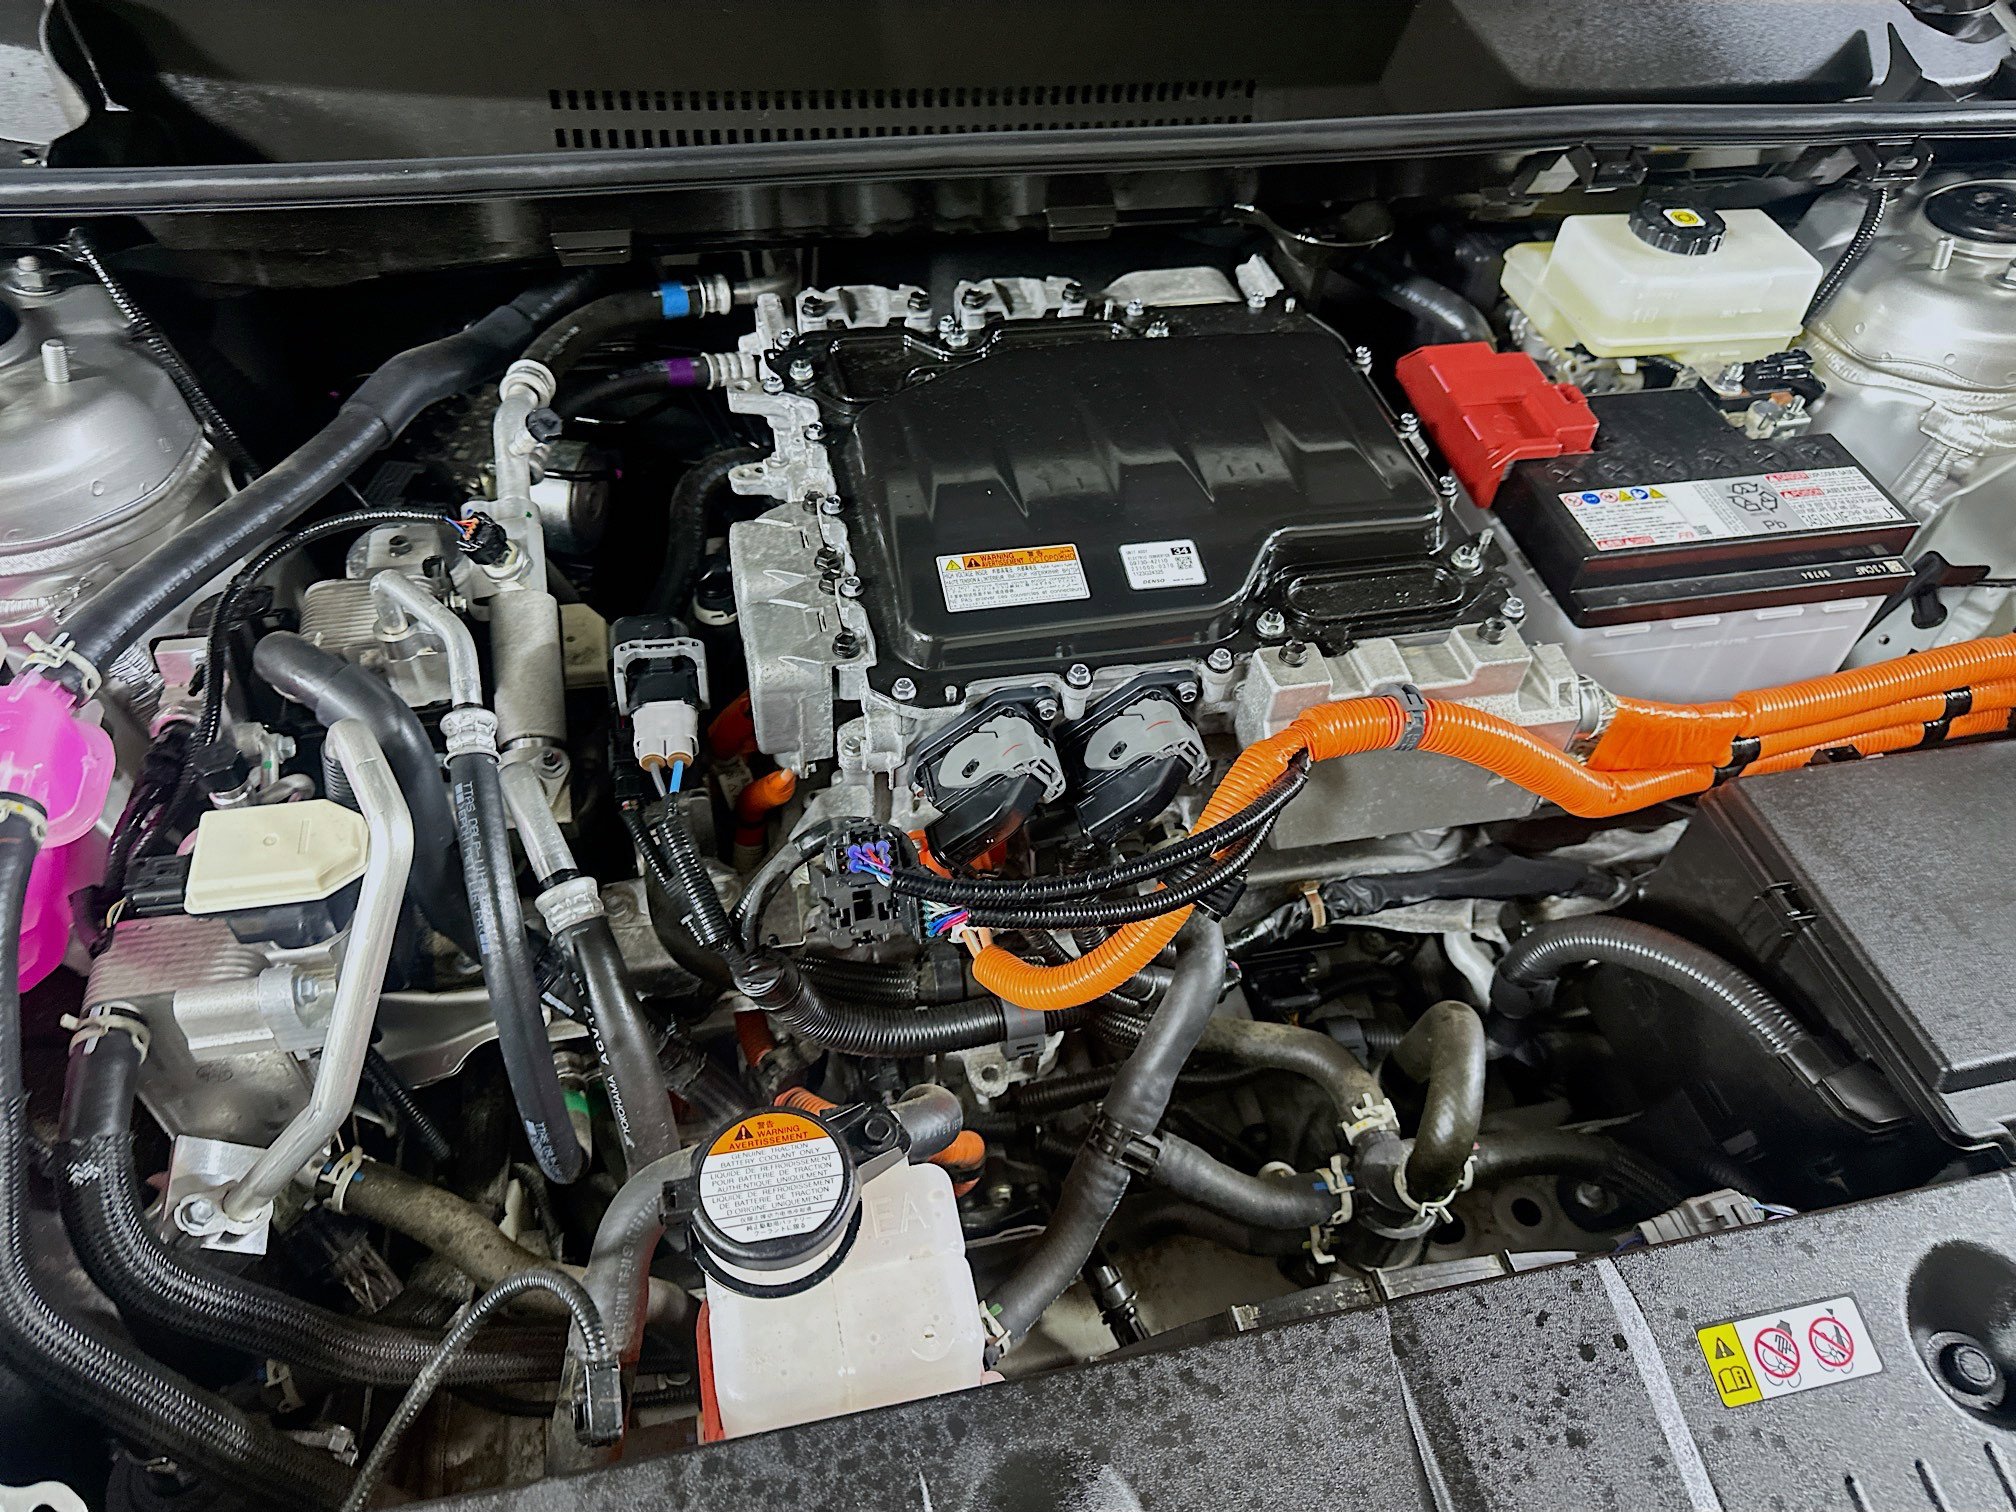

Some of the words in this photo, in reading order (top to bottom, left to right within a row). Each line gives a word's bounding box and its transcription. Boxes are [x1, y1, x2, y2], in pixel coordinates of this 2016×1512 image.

[1763, 519, 1787, 530] Pb
[980, 553, 1014, 561] WARNING
[981, 558, 1025, 567] AVERTISSEMENT
[583, 1005, 610, 1066] ACV17
[607, 1074, 632, 1141] YOKOHAMA
[756, 1120, 775, 1130] 警告
[757, 1124, 800, 1138] WARNING
[729, 1131, 808, 1151] AVERTISSEMENT
[731, 1150, 765, 1160] GENUINE
[771, 1142, 809, 1154] TRACTION
[710, 1169, 741, 1180] LIQUIDE
[760, 1154, 832, 1172] REFROIDISSEMENT
[720, 1158, 755, 1169] BATTERY
[758, 1151, 795, 1163] COOLANT
[799, 1147, 821, 1156] ONLY
[711, 1178, 734, 1187] POUR
[738, 1171, 775, 1183] BATTERIE
[794, 1162, 832, 1174] TRACTION
[717, 1179, 772, 1193] AUTHENTIQUE
[776, 1169, 828, 1184] UNIQUEMENT
[712, 1193, 743, 1204] LIQUIDE
[762, 1177, 835, 1196] REFROIDISSEMENT
[734, 1196, 772, 1208] BATTERIE
[791, 1186, 830, 1198] TRACTION
[771, 1194, 824, 1209] UNIQUEMENT
